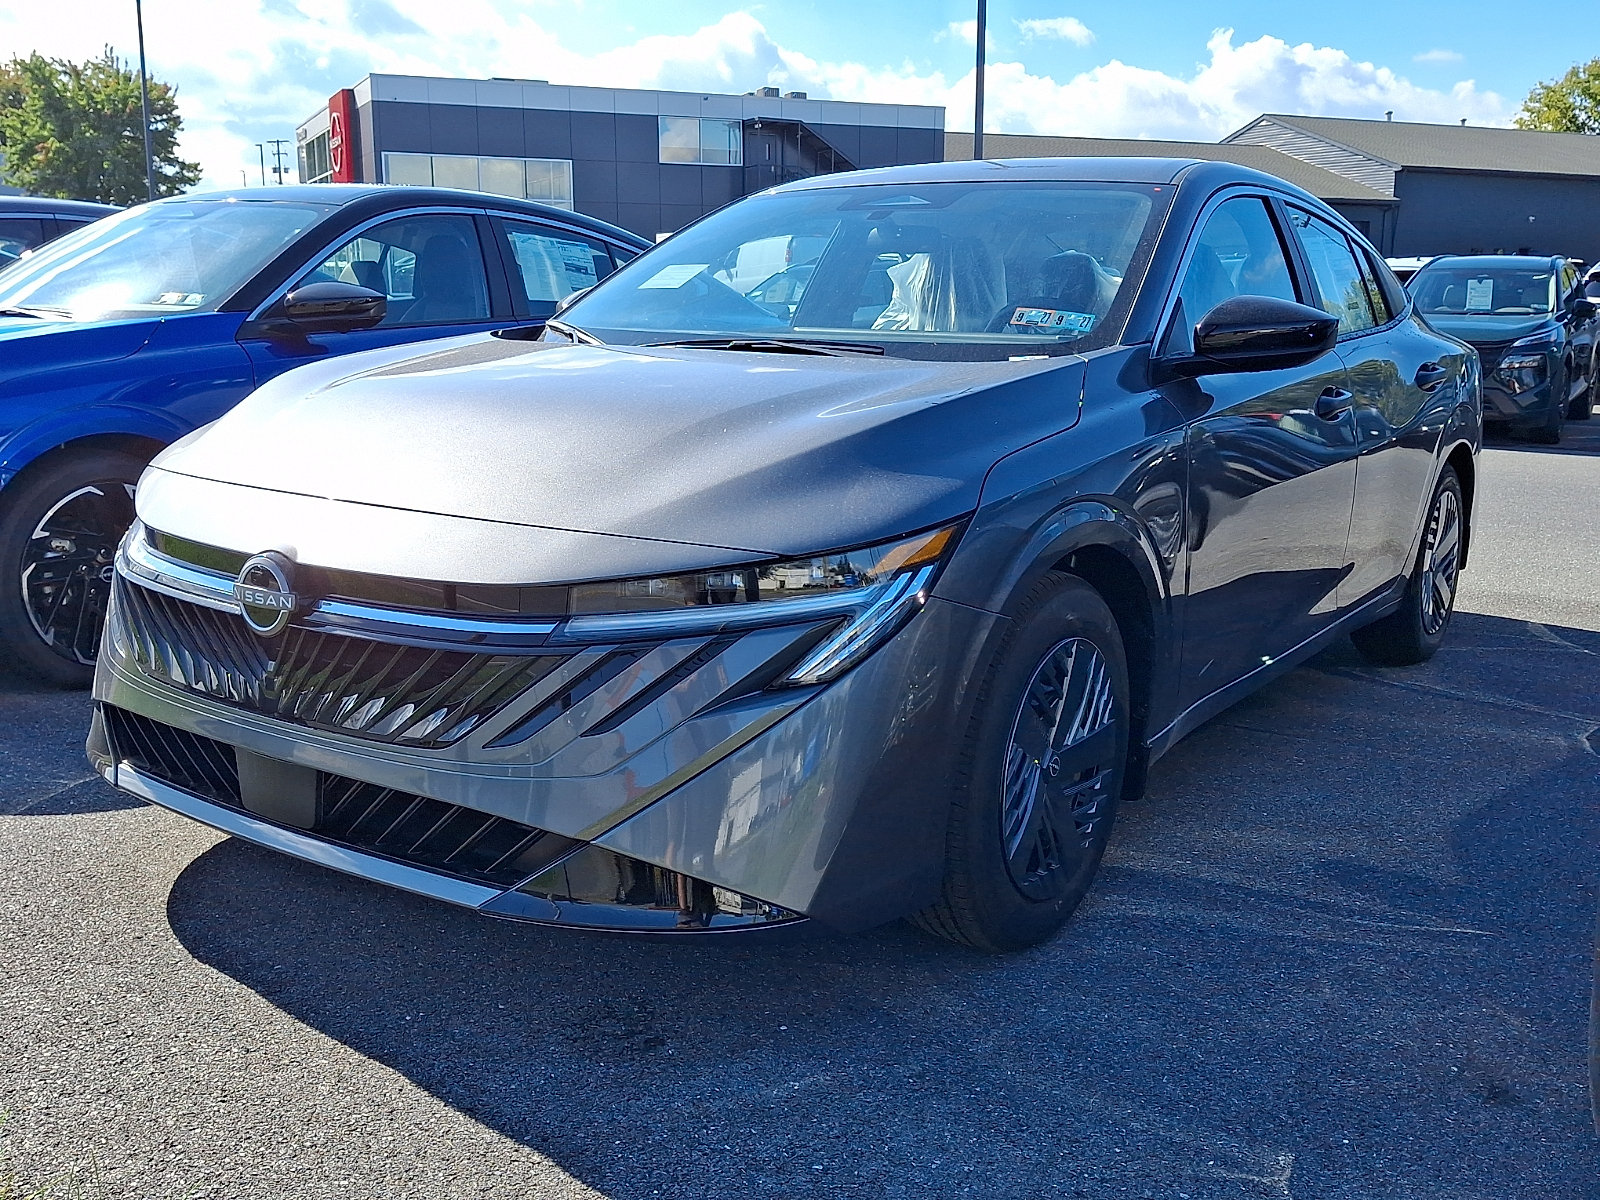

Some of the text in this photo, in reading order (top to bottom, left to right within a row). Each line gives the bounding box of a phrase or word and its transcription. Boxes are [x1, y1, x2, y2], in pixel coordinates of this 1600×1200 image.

[1016, 311, 1052, 324] 9 27
[1056, 315, 1092, 328] 9 27
[233, 587, 292, 608] NISSAN
